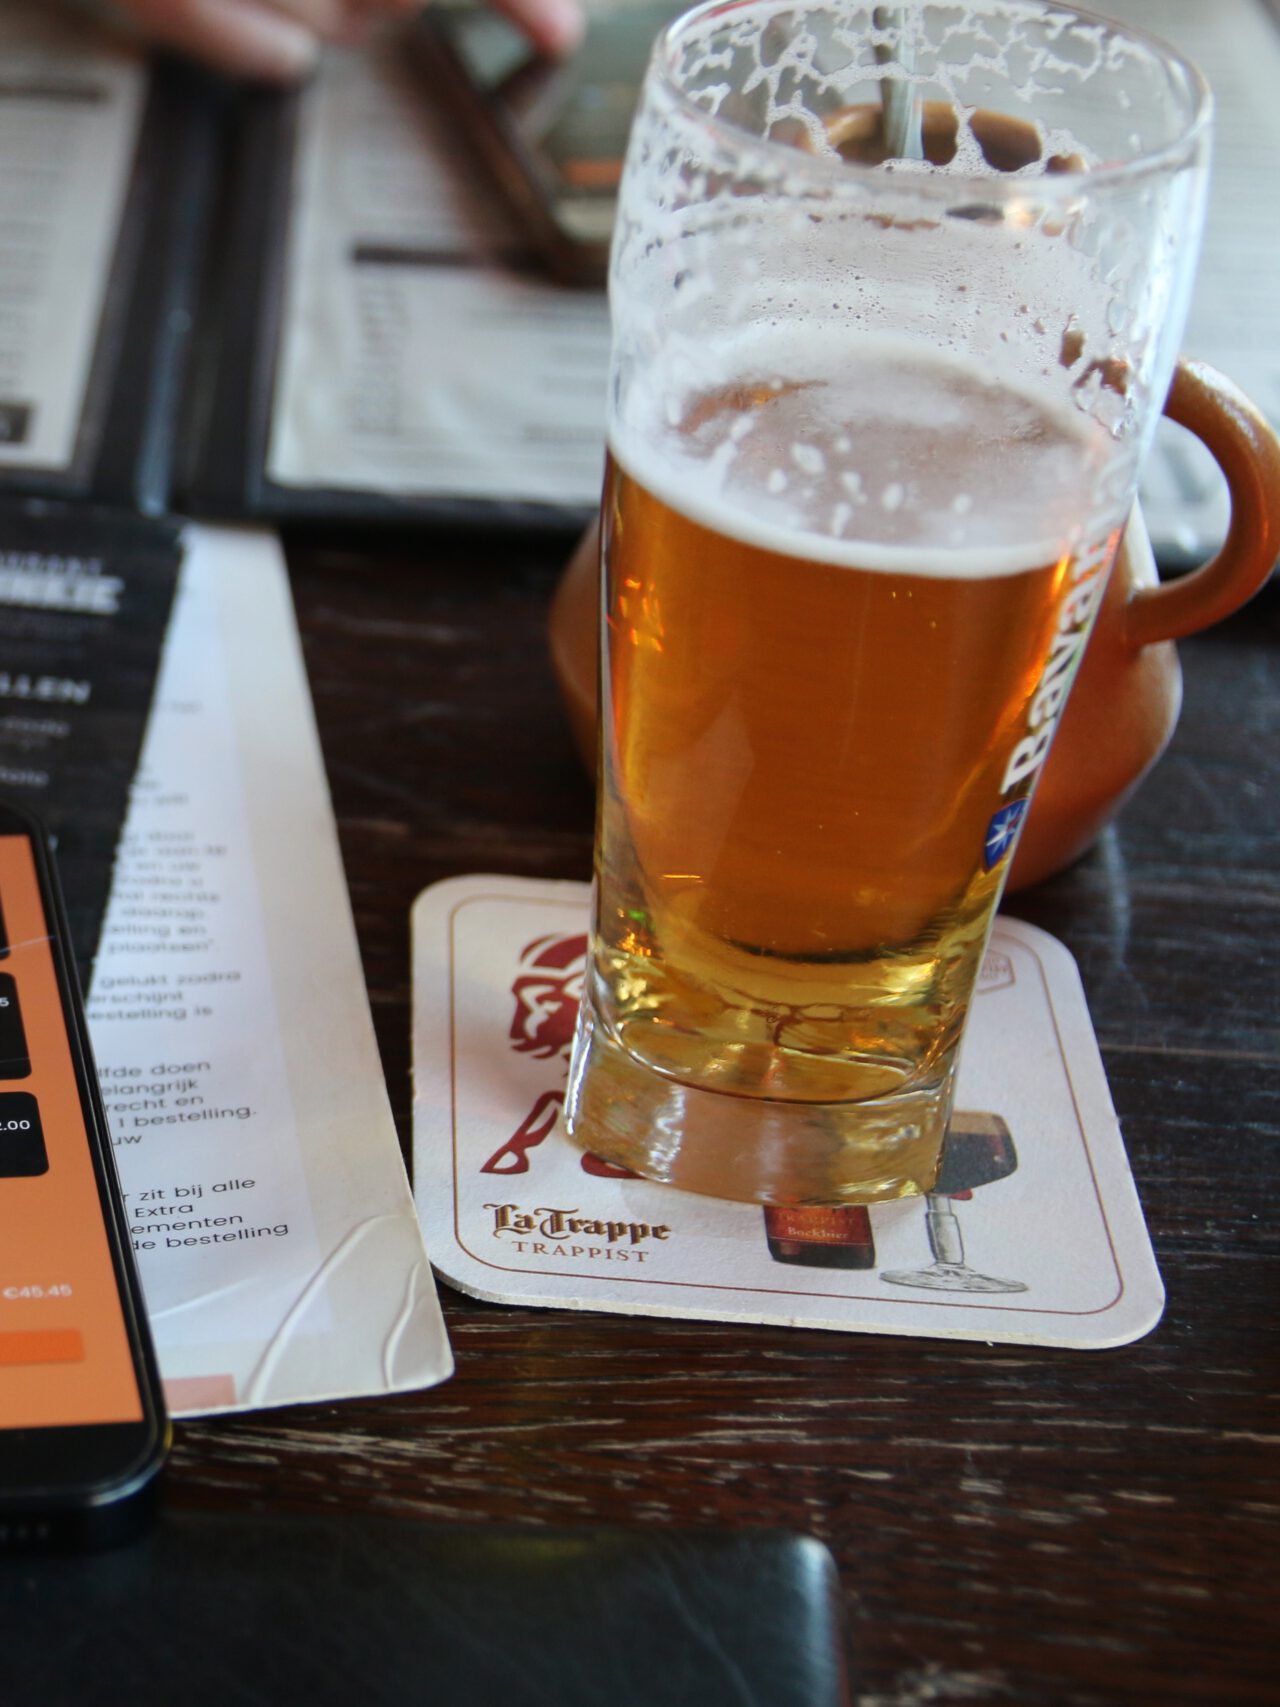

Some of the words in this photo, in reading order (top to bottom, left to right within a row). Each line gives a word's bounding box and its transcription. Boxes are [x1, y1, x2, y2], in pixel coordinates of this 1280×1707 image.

[89, 988, 184, 1004] erschijnt
[89, 1007, 187, 1021] estelling
[195, 1005, 214, 1017] is
[98, 1066, 143, 1079] lfde
[150, 1060, 211, 1077] doen
[102, 1079, 200, 1097] elangrijk
[106, 1099, 168, 1112] recht
[175, 1095, 205, 1107] en
[134, 1106, 257, 1128] bestelling.
[139, 1189, 166, 1201] zit
[175, 1184, 203, 1198] bij
[212, 1179, 256, 1193] alle
[135, 1203, 194, 1218] Extra
[131, 1214, 244, 1234] ementen
[482, 1202, 538, 1239] La
[533, 1207, 673, 1245] Trappe
[787, 1225, 849, 1239] Bockbier
[166, 1223, 290, 1248] bestelling
[511, 1240, 649, 1263] TRAPPIST
[2, 1284, 72, 1299] €45.45
